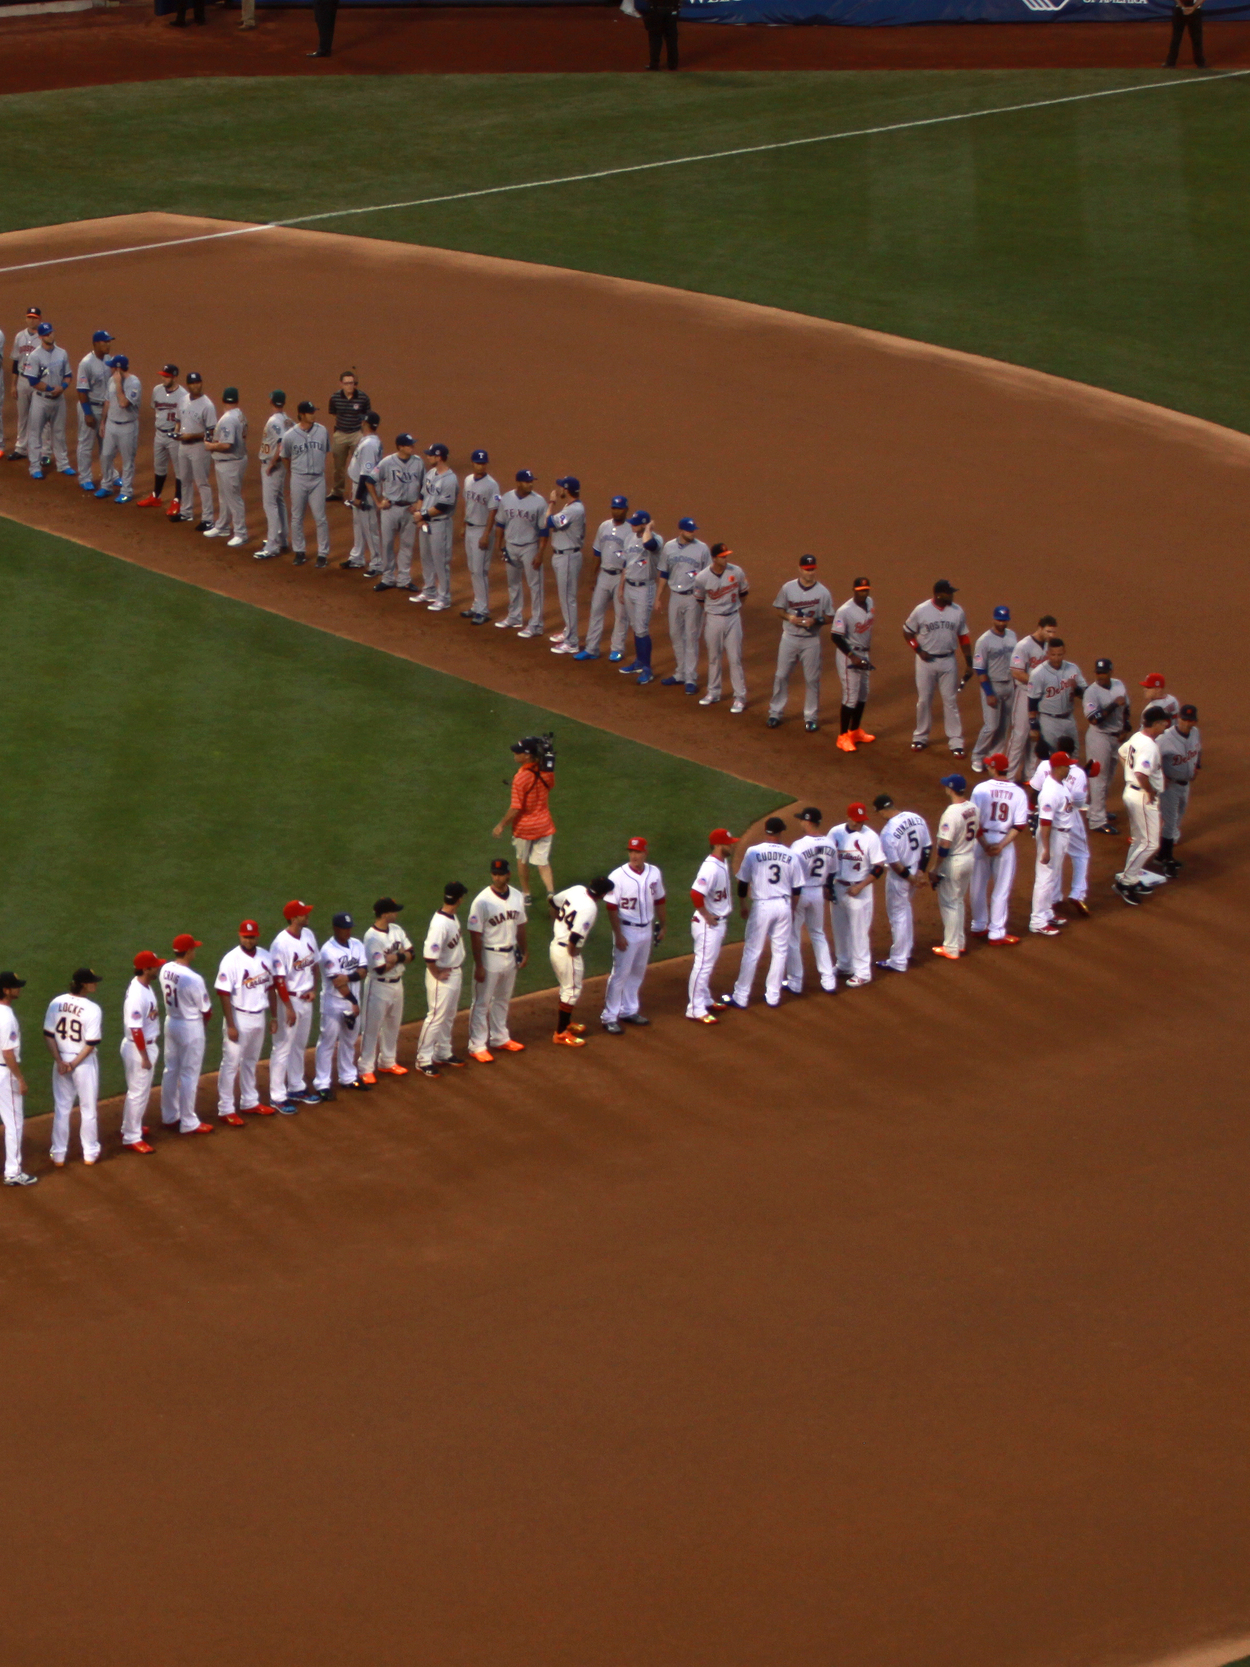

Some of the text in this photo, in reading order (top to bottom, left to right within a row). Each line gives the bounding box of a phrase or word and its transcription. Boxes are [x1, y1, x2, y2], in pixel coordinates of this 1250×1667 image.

[292, 441, 323, 455] SEATTL
[465, 490, 488, 506] EXAS
[504, 508, 537, 522] TEXAS
[925, 620, 956, 631] BOSTON
[991, 789, 1013, 801] VOTTO
[991, 801, 1009, 822] 19
[892, 818, 924, 840] GONZALEZ
[966, 821, 975, 842] 5
[907, 830, 919, 851] 5
[755, 852, 792, 865] CUDDYER
[768, 863, 780, 884] 3
[810, 857, 824, 877] 2
[853, 862, 860, 872] 4
[620, 897, 638, 910] 27
[164, 983, 179, 1008] 21
[58, 1002, 85, 1018] LOCKE
[55, 1016, 83, 1043] 49
